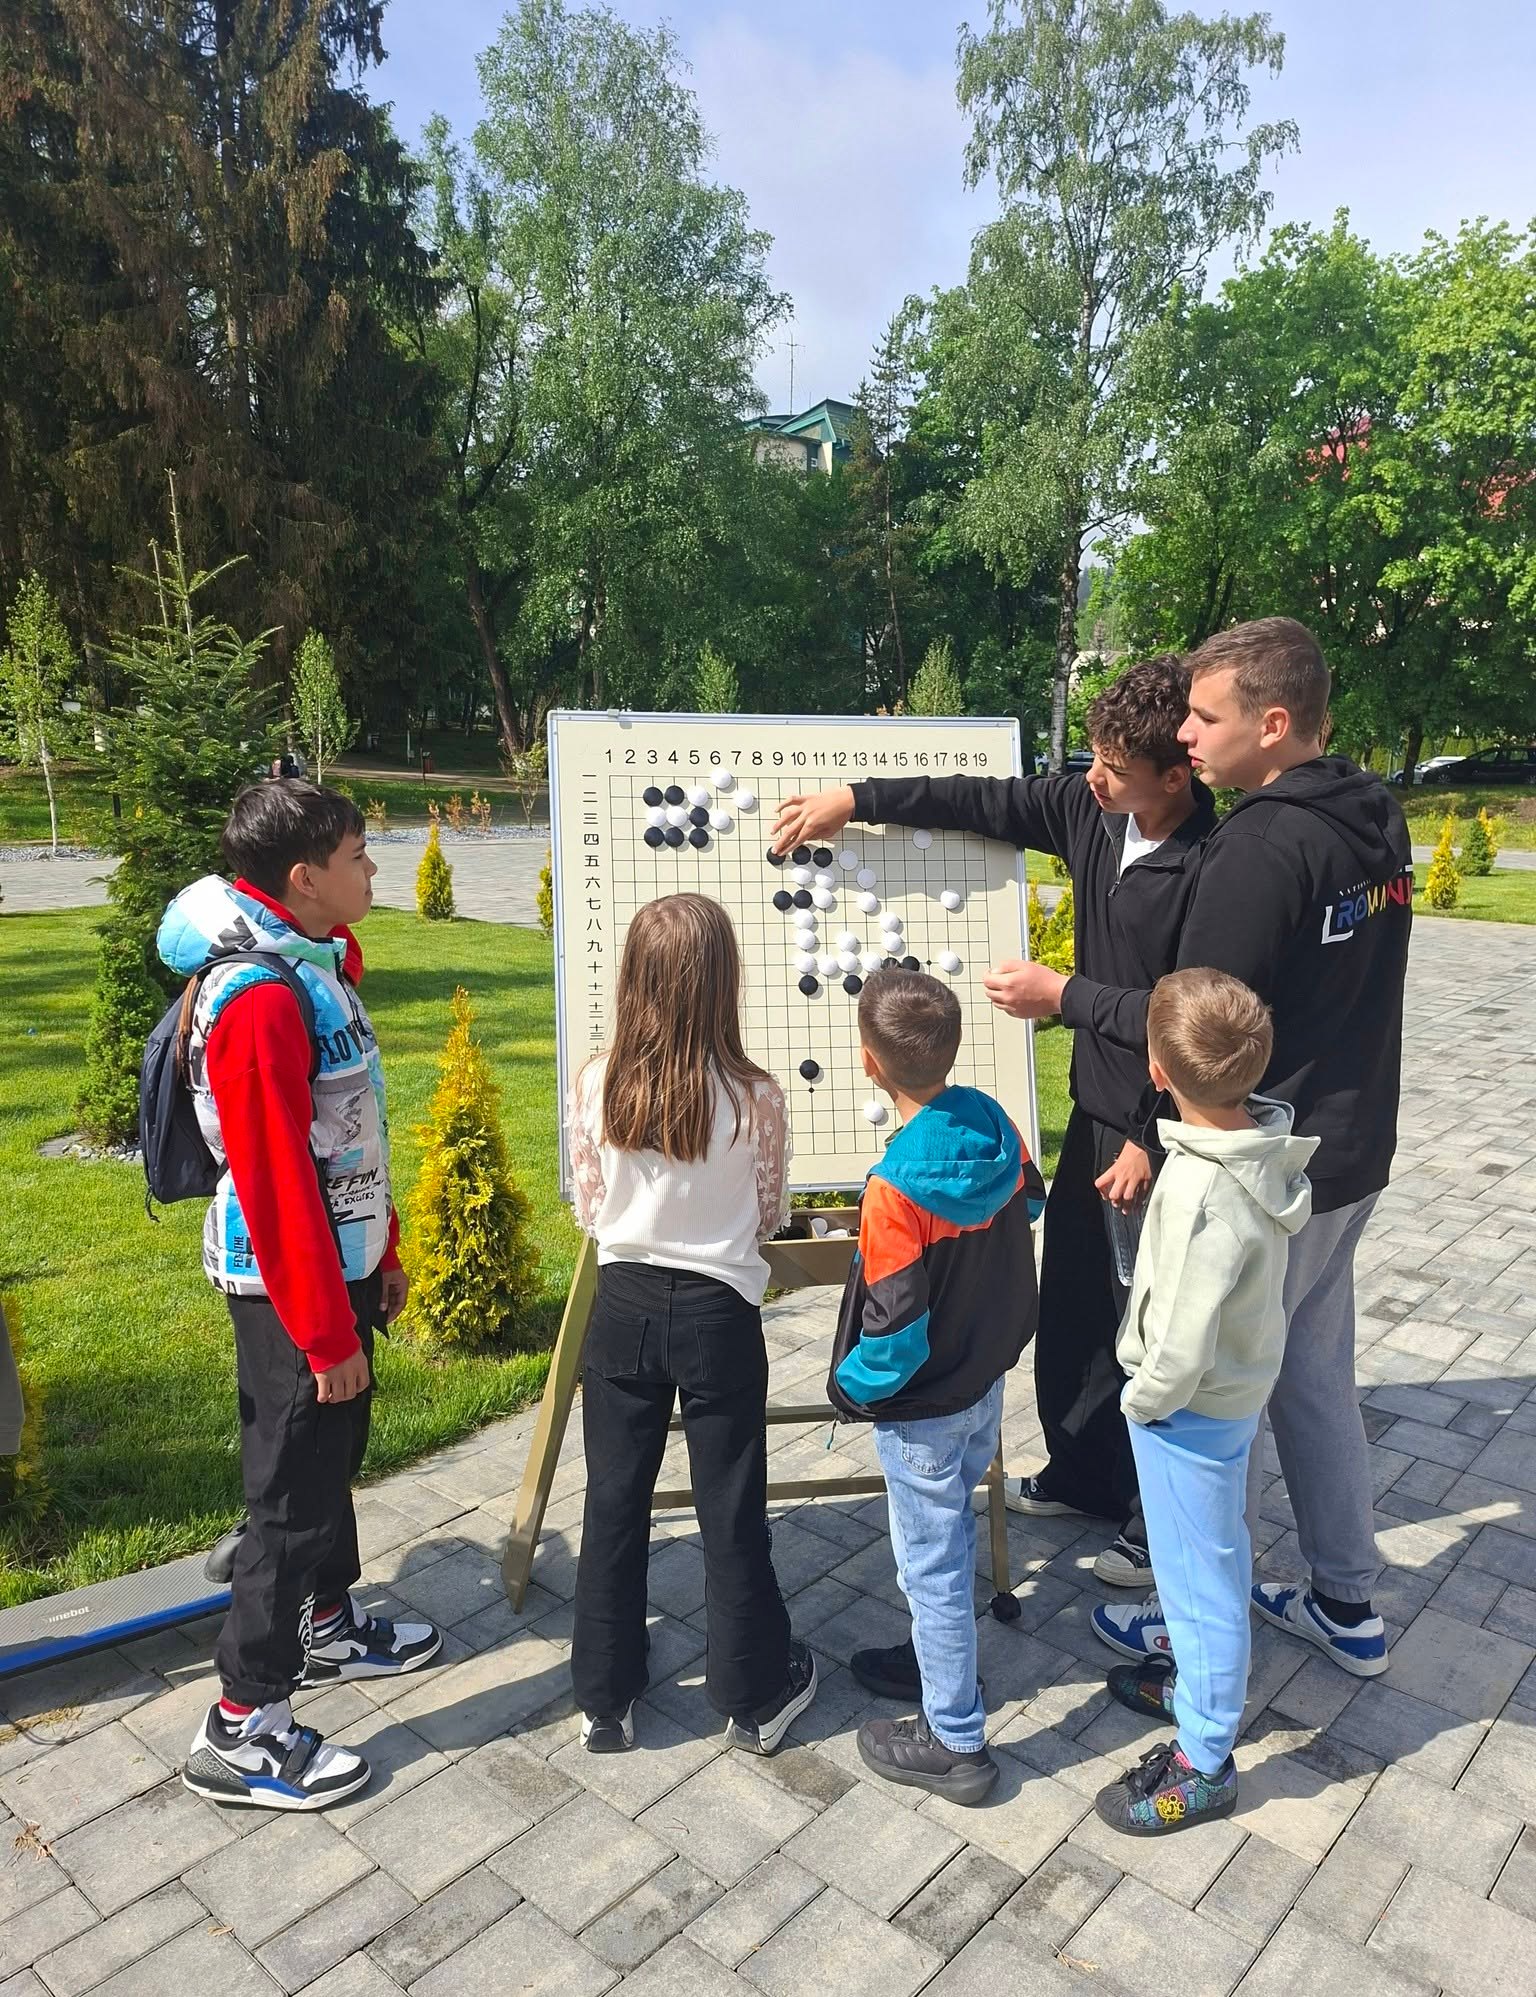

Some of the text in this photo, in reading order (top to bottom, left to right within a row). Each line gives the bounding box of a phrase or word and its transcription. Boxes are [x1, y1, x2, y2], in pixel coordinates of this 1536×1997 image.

[606, 748, 988, 767] 1 2 3 4 5 6 7 8 9 10 11 12 13 14 15 16 17 18 19
[583, 791, 597, 803] 二
[583, 812, 598, 826] 三
[583, 833, 600, 846] 四
[584, 854, 600, 867] 五
[585, 875, 601, 889] 六
[584, 897, 601, 910] 七
[586, 918, 602, 931] 八
[586, 939, 603, 953] 九
[587, 961, 603, 974] 十
